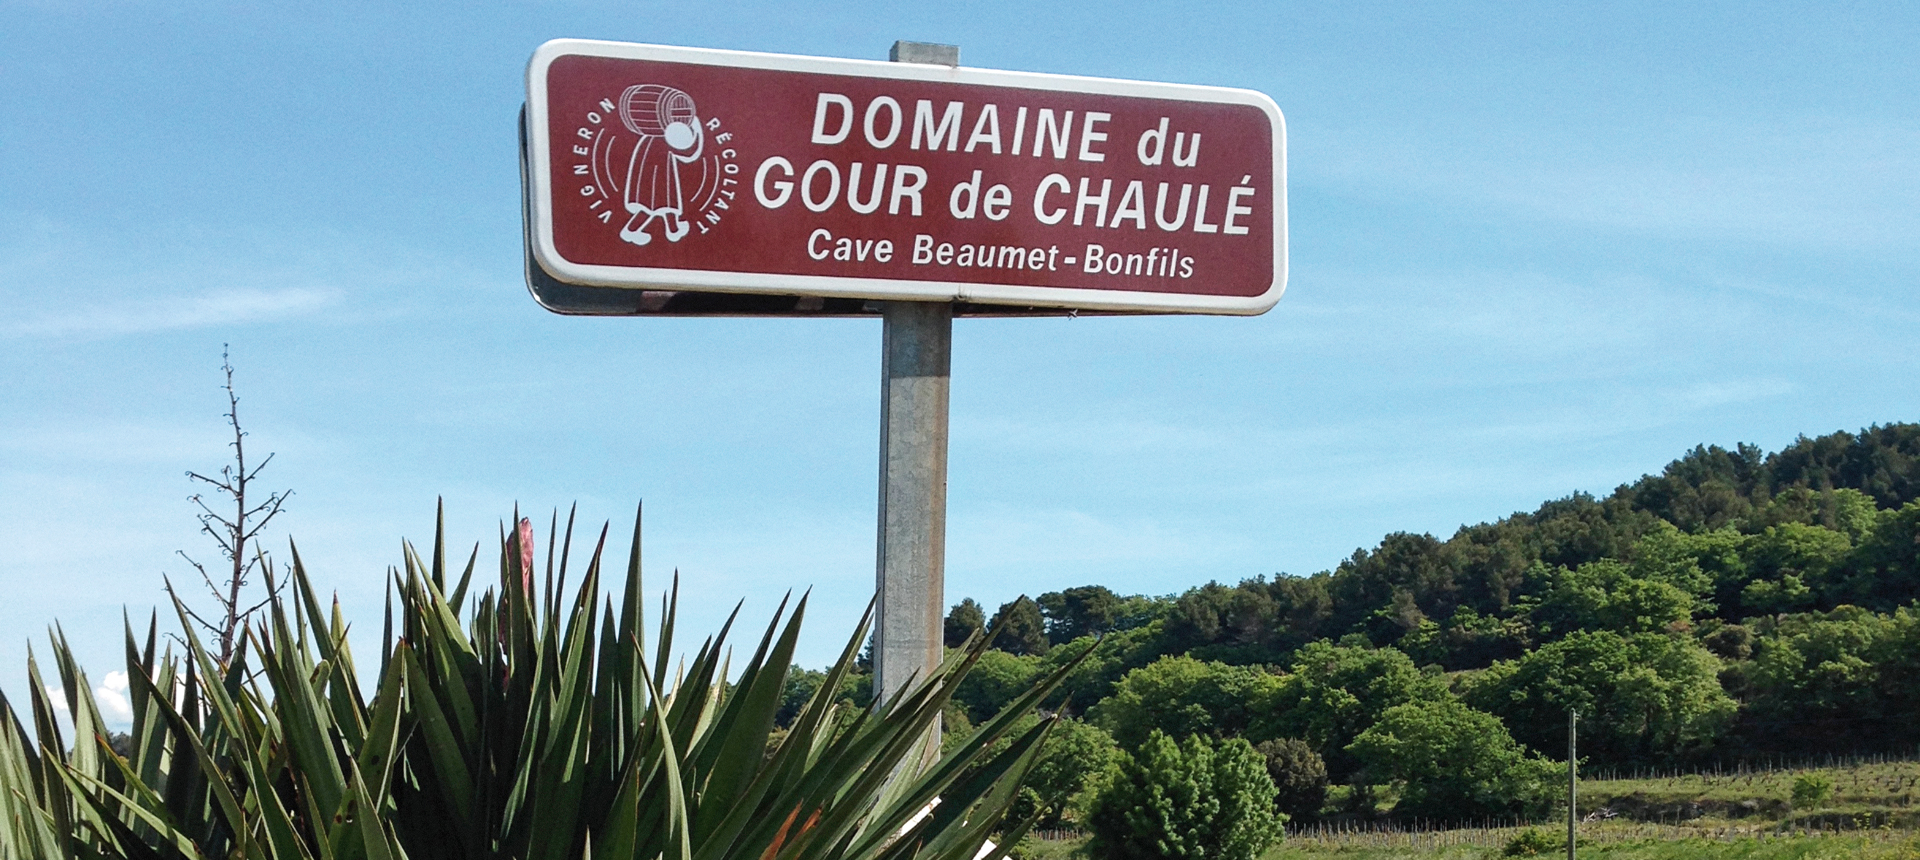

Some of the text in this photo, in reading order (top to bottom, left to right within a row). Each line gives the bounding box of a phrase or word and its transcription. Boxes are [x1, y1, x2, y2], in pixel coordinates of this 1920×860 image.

[573, 98, 615, 224] VIGNERON
[811, 92, 1202, 168] DOMAINE du
[697, 117, 739, 234] RÉCOLTANT
[753, 156, 1256, 235] GOUR de CHAULÉ
[807, 228, 1195, 279] Cave Beaumet-Bonfils
